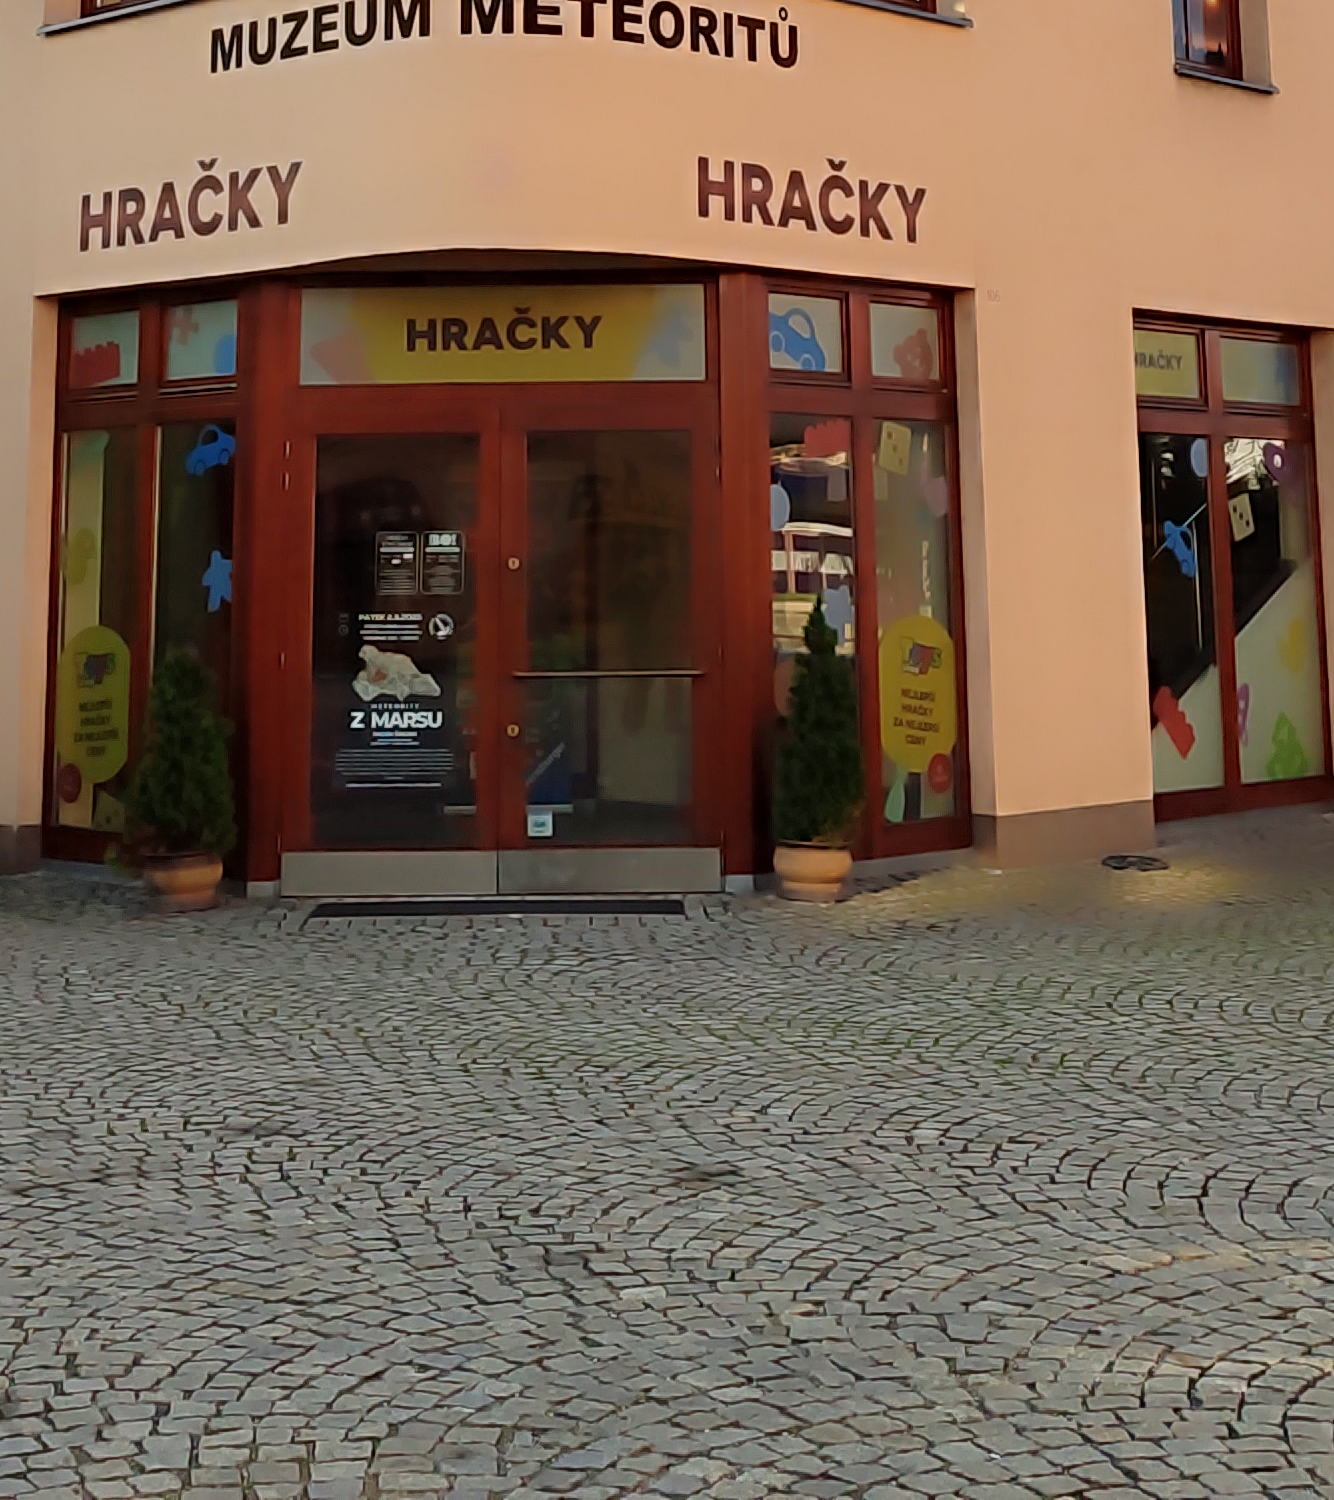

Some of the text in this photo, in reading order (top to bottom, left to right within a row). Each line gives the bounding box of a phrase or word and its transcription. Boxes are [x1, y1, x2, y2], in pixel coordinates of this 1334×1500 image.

[79, 157, 303, 252] HRAČKY
[697, 156, 928, 244] HRAČKY
[405, 307, 601, 353] HRAČKY
[350, 711, 443, 729] Z MARSU
